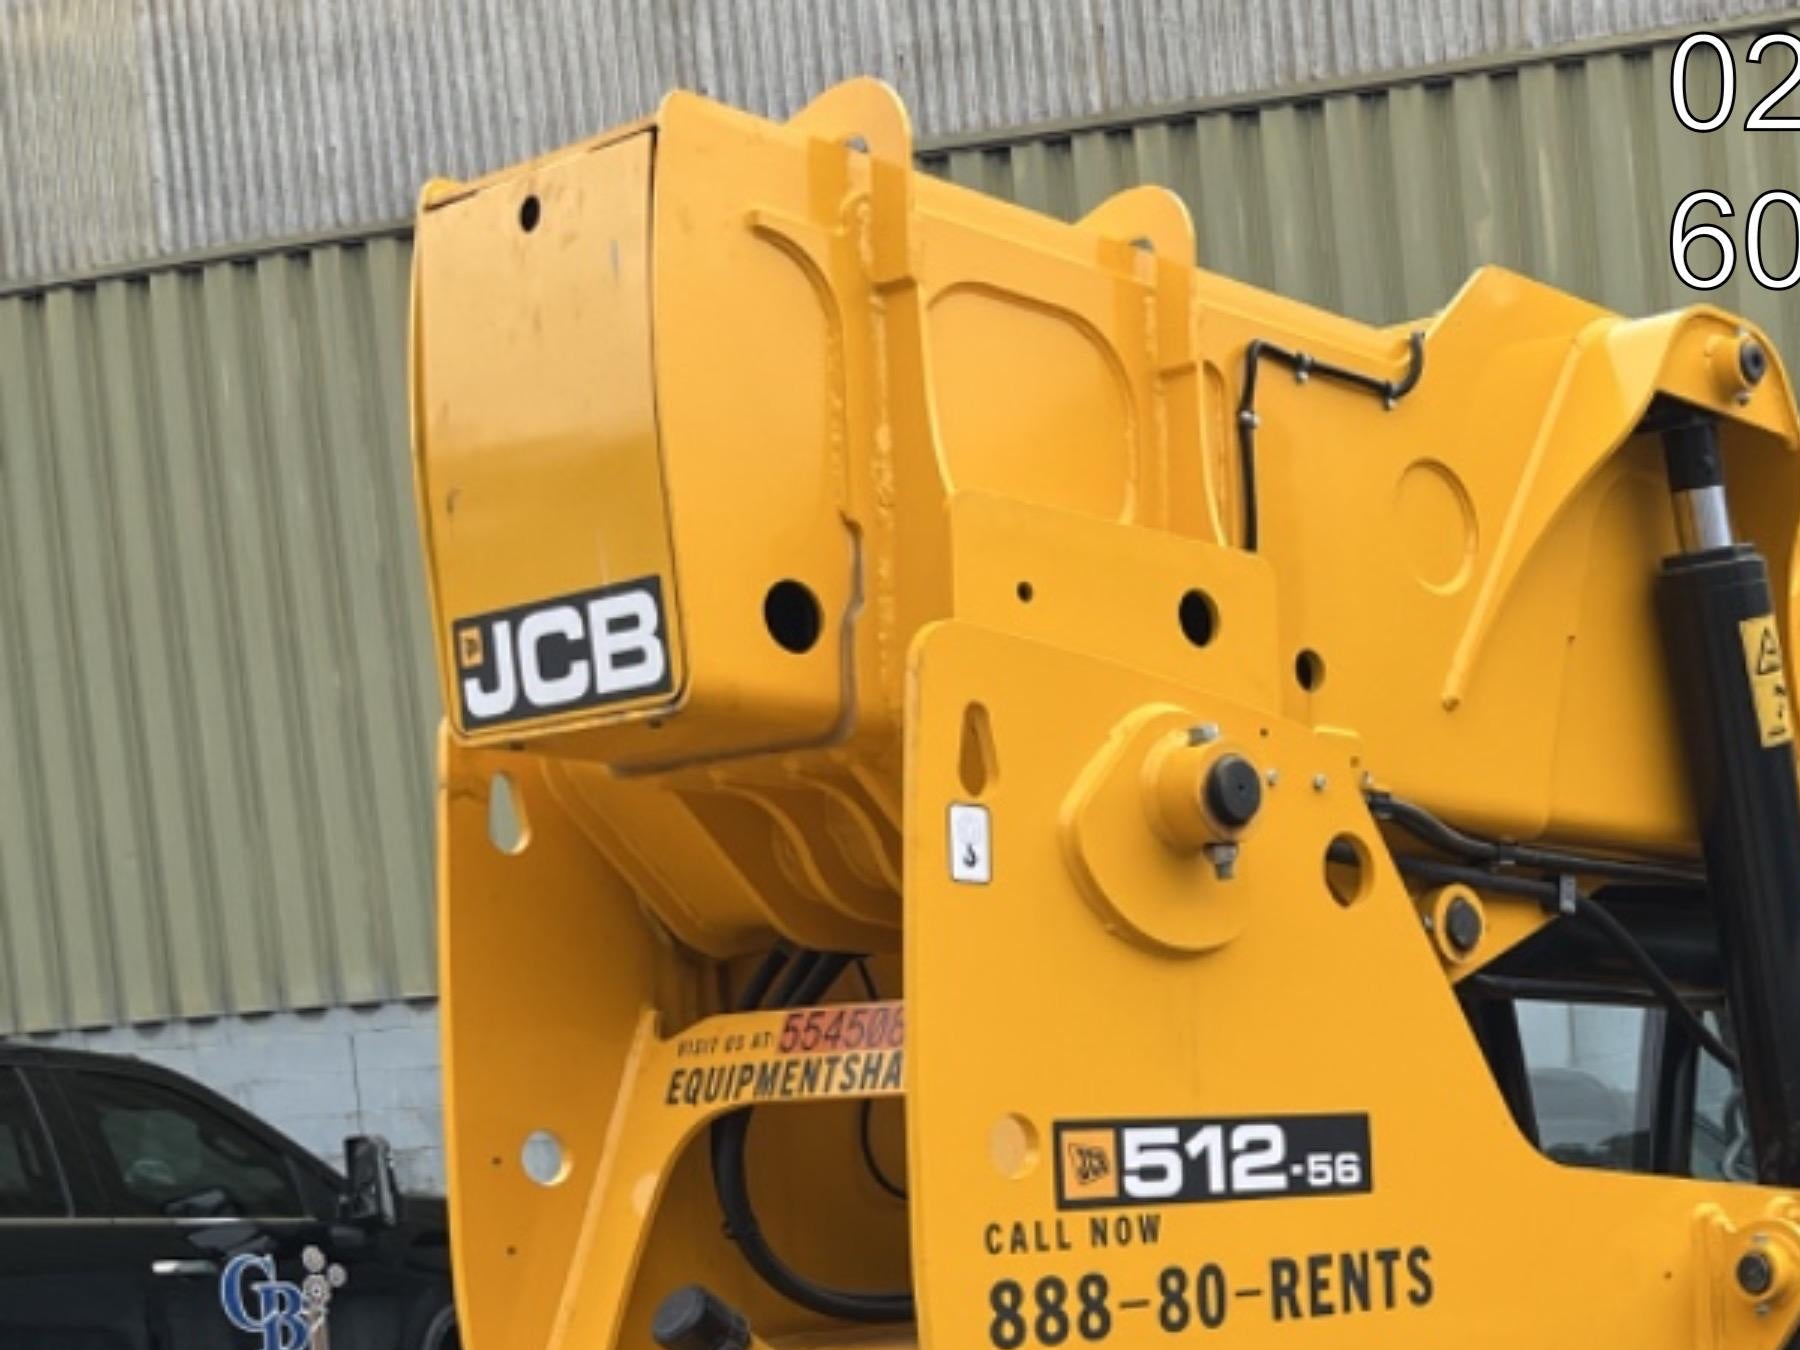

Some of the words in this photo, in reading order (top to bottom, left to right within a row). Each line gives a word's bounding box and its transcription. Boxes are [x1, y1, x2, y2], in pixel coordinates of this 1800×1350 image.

[463, 588, 666, 718] JCB
[984, 1218, 1072, 1255] CALL
[1090, 1214, 1162, 1247] NOW
[988, 1245, 1435, 1350] 888-80-RENTS
